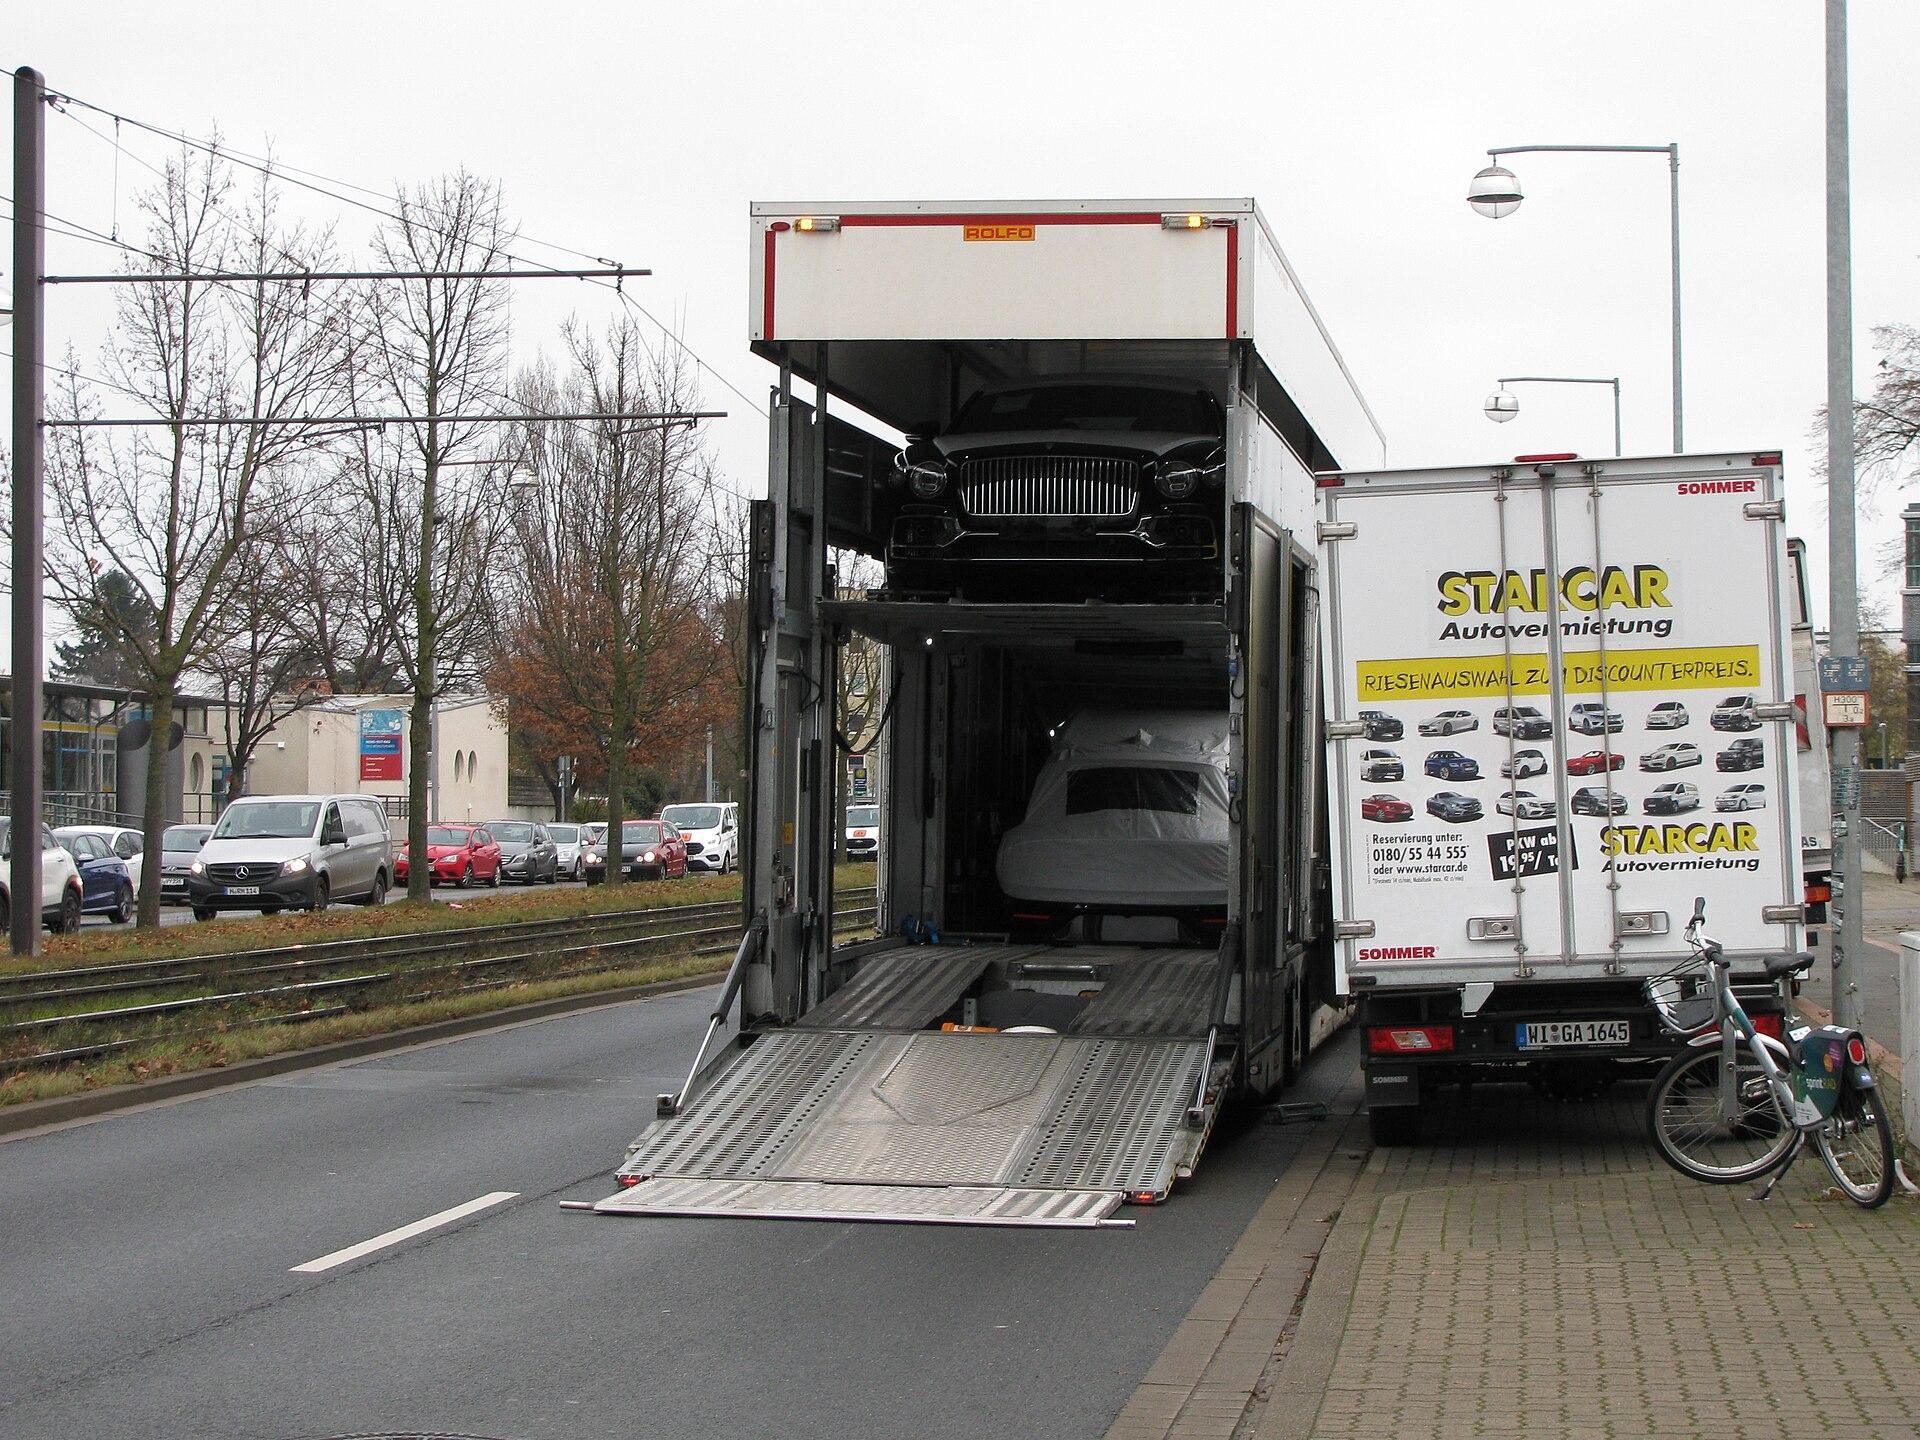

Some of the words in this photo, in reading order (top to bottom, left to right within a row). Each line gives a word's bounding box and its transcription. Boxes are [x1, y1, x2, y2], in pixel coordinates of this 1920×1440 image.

[966, 228, 1033, 239] ROLFO
[1677, 480, 1756, 496] SOMMER
[1437, 564, 1673, 616] STARCAR
[1364, 669, 1519, 691] RIESENAUSWAHL
[1574, 660, 1753, 684] DISCOUNTERPREIS.
[1373, 833, 1432, 845] Reservierung
[1435, 833, 1462, 842] unter:
[1540, 832, 1557, 846] ab
[1600, 822, 1759, 856] STARCAR
[1373, 847, 1422, 863] 0180/55
[1427, 847, 1441, 859] 44
[1374, 864, 1393, 875] oder
[1397, 861, 1468, 874] www.starcar.de
[1601, 857, 1759, 872] Autovermietung
[1359, 946, 1436, 960] SOMMER
[1528, 1025, 1548, 1043] WI
[1562, 1024, 1583, 1042] GA
[1587, 1022, 1628, 1041] 1645
[1372, 1075, 1408, 1084] SOMMER
